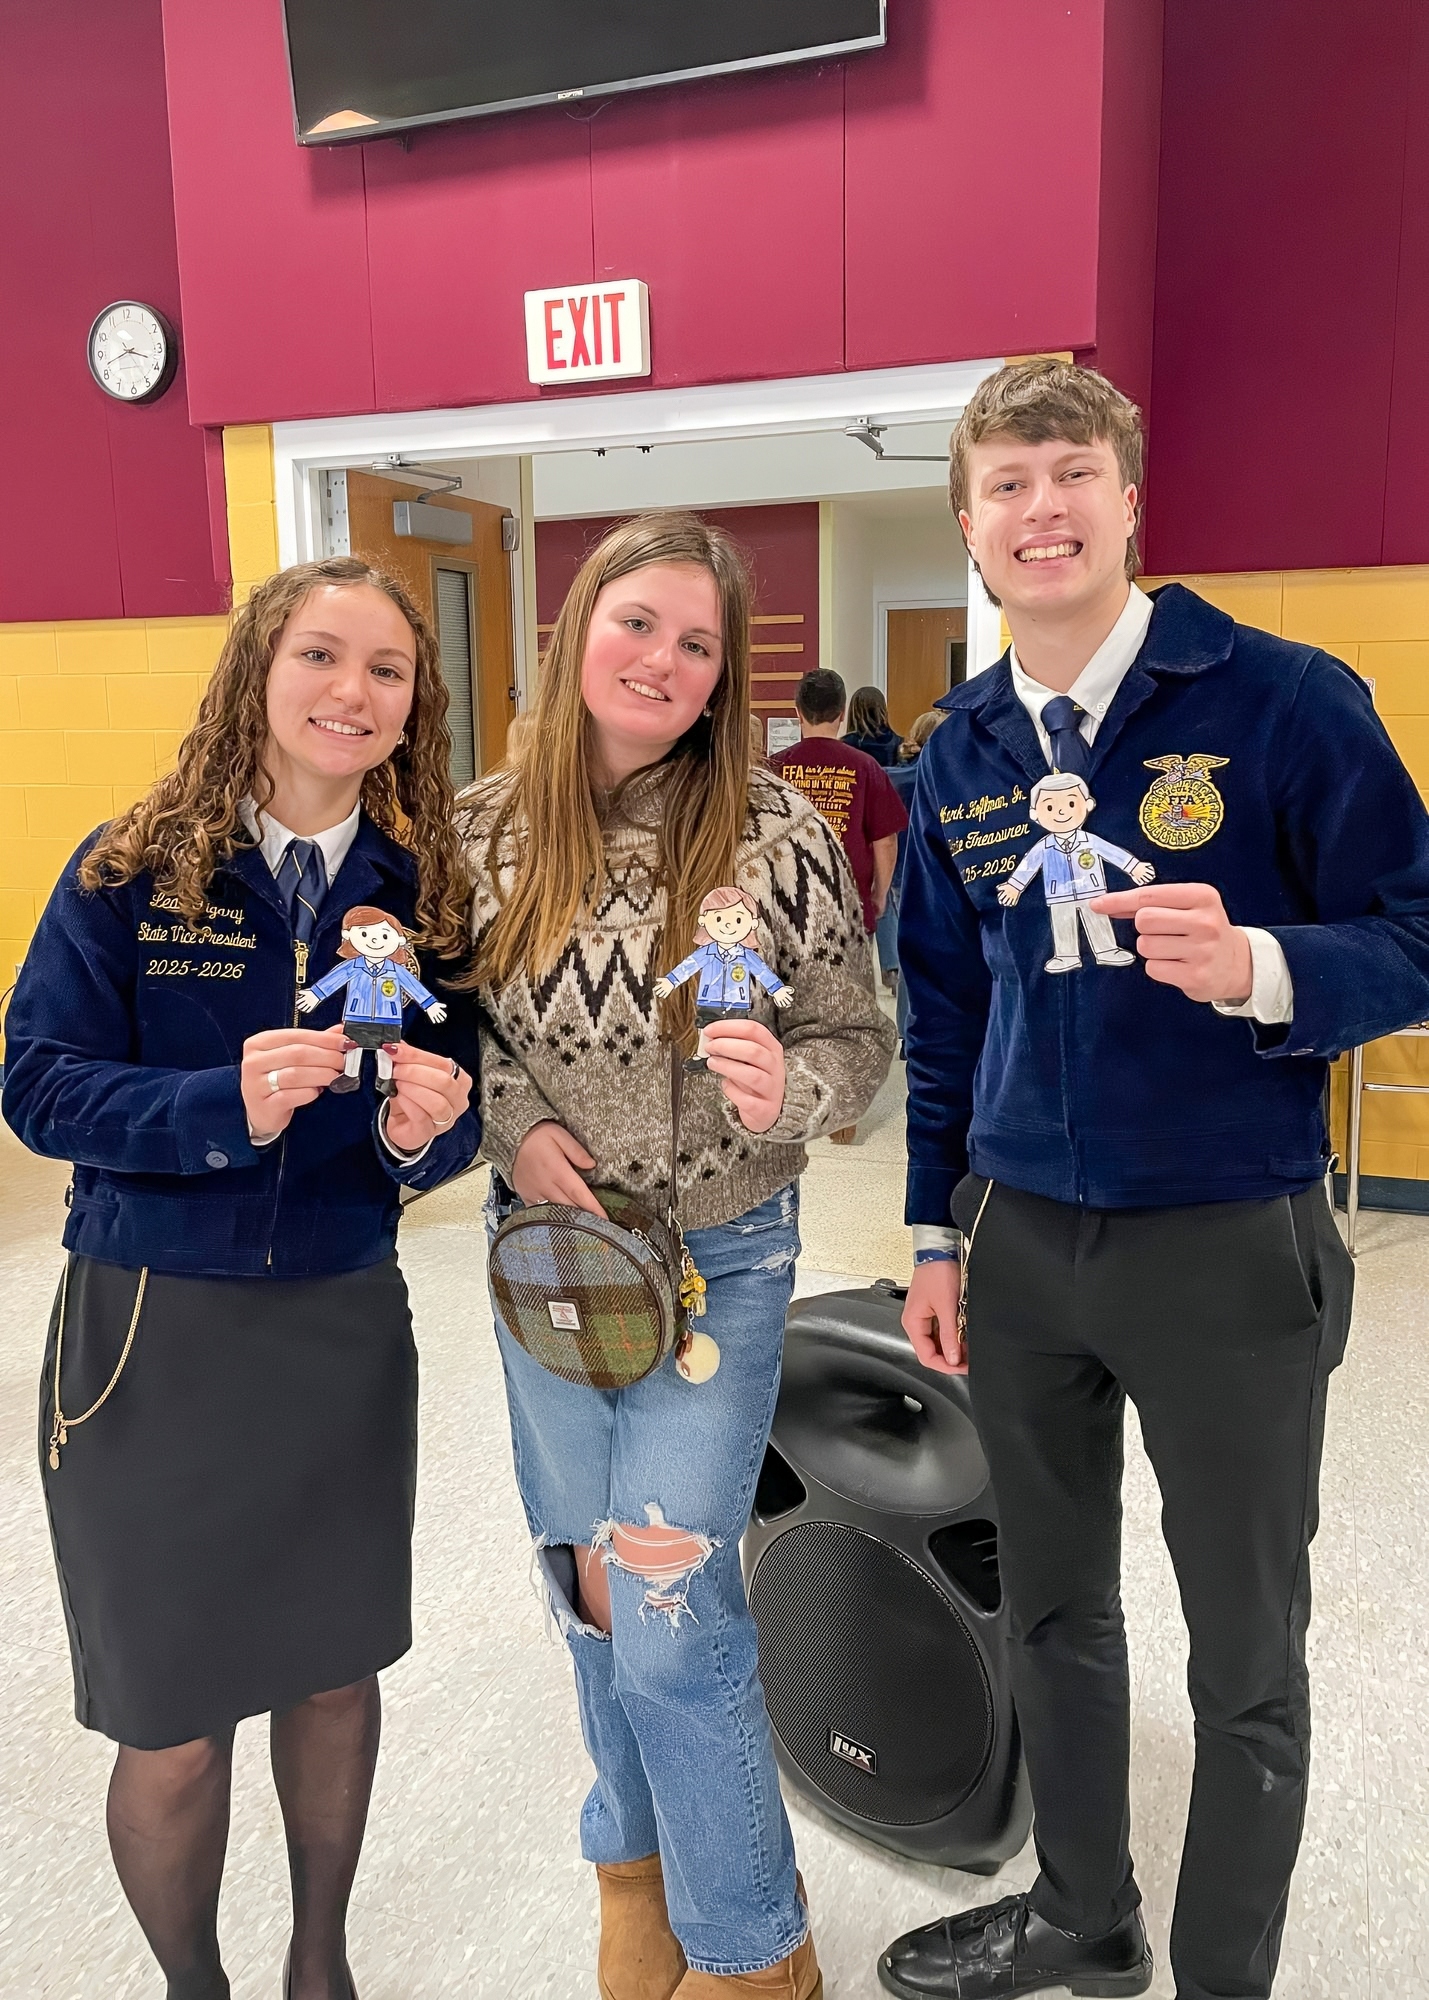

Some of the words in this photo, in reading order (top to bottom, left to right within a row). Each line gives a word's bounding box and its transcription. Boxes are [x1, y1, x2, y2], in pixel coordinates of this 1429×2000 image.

[122, 308, 131, 320] 12
[108, 316, 116, 328] 11
[151, 323, 158, 334] 2
[544, 292, 625, 370] EXIT
[98, 332, 108, 342] 10
[157, 342, 163, 353] 3
[97, 350, 104, 360] 9
[153, 361, 160, 371] 4
[103, 369, 110, 380] 8
[116, 382, 122, 392] 7
[145, 377, 151, 388] 5
[130, 383, 137, 395] 6
[782, 764, 804, 780] FFA
[820, 781, 833, 790] THE
[1168, 795, 1196, 806] FFA
[965, 823, 1031, 849] Treasurer
[962, 855, 1017, 885] 25-2026
[137, 922, 168, 941] State
[170, 925, 197, 944] Vice
[198, 926, 257, 949] President
[145, 959, 246, 979] 2025-2026
